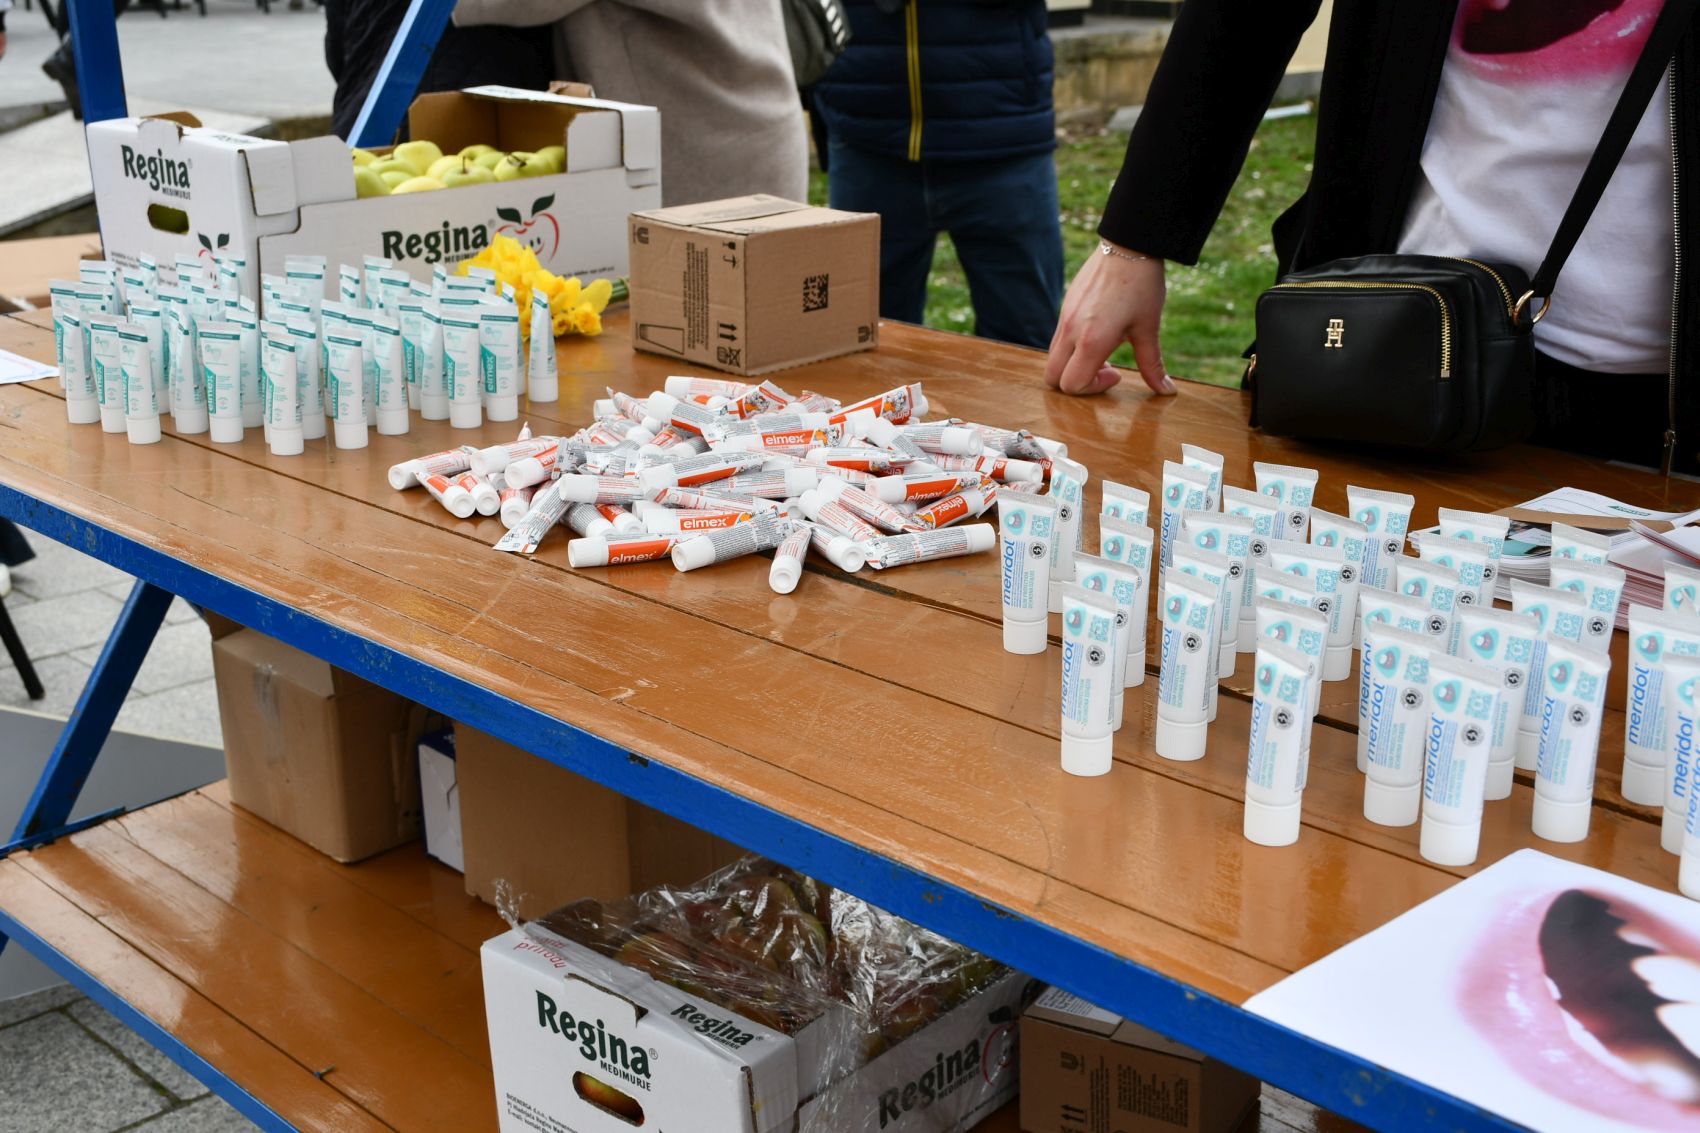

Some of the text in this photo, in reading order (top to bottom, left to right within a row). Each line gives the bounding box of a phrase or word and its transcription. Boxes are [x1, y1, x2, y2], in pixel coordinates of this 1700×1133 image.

[121, 145, 190, 191] Regina
[381, 220, 488, 264] Regina
[485, 356, 494, 390] elmex
[765, 434, 805, 446] elmex
[683, 517, 727, 529] elmex
[906, 491, 943, 502] elmex
[938, 496, 964, 515] elmex
[611, 551, 653, 565] elmex
[1003, 539, 1015, 606] meridol
[1159, 511, 1171, 576] meridol
[1061, 640, 1074, 716] meridol
[1158, 627, 1172, 700] meridol
[1360, 642, 1371, 719] meridol
[1367, 681, 1385, 762] meridol
[1536, 697, 1555, 775] meridol
[1628, 666, 1649, 745] meridol
[1424, 716, 1444, 800] meridol
[1673, 714, 1693, 798] meridol
[536, 990, 652, 1079] Regina
[670, 1003, 755, 1046] Regina
[600, 1060, 651, 1091] MEĐIMURJE
[878, 1039, 981, 1129] Regina
